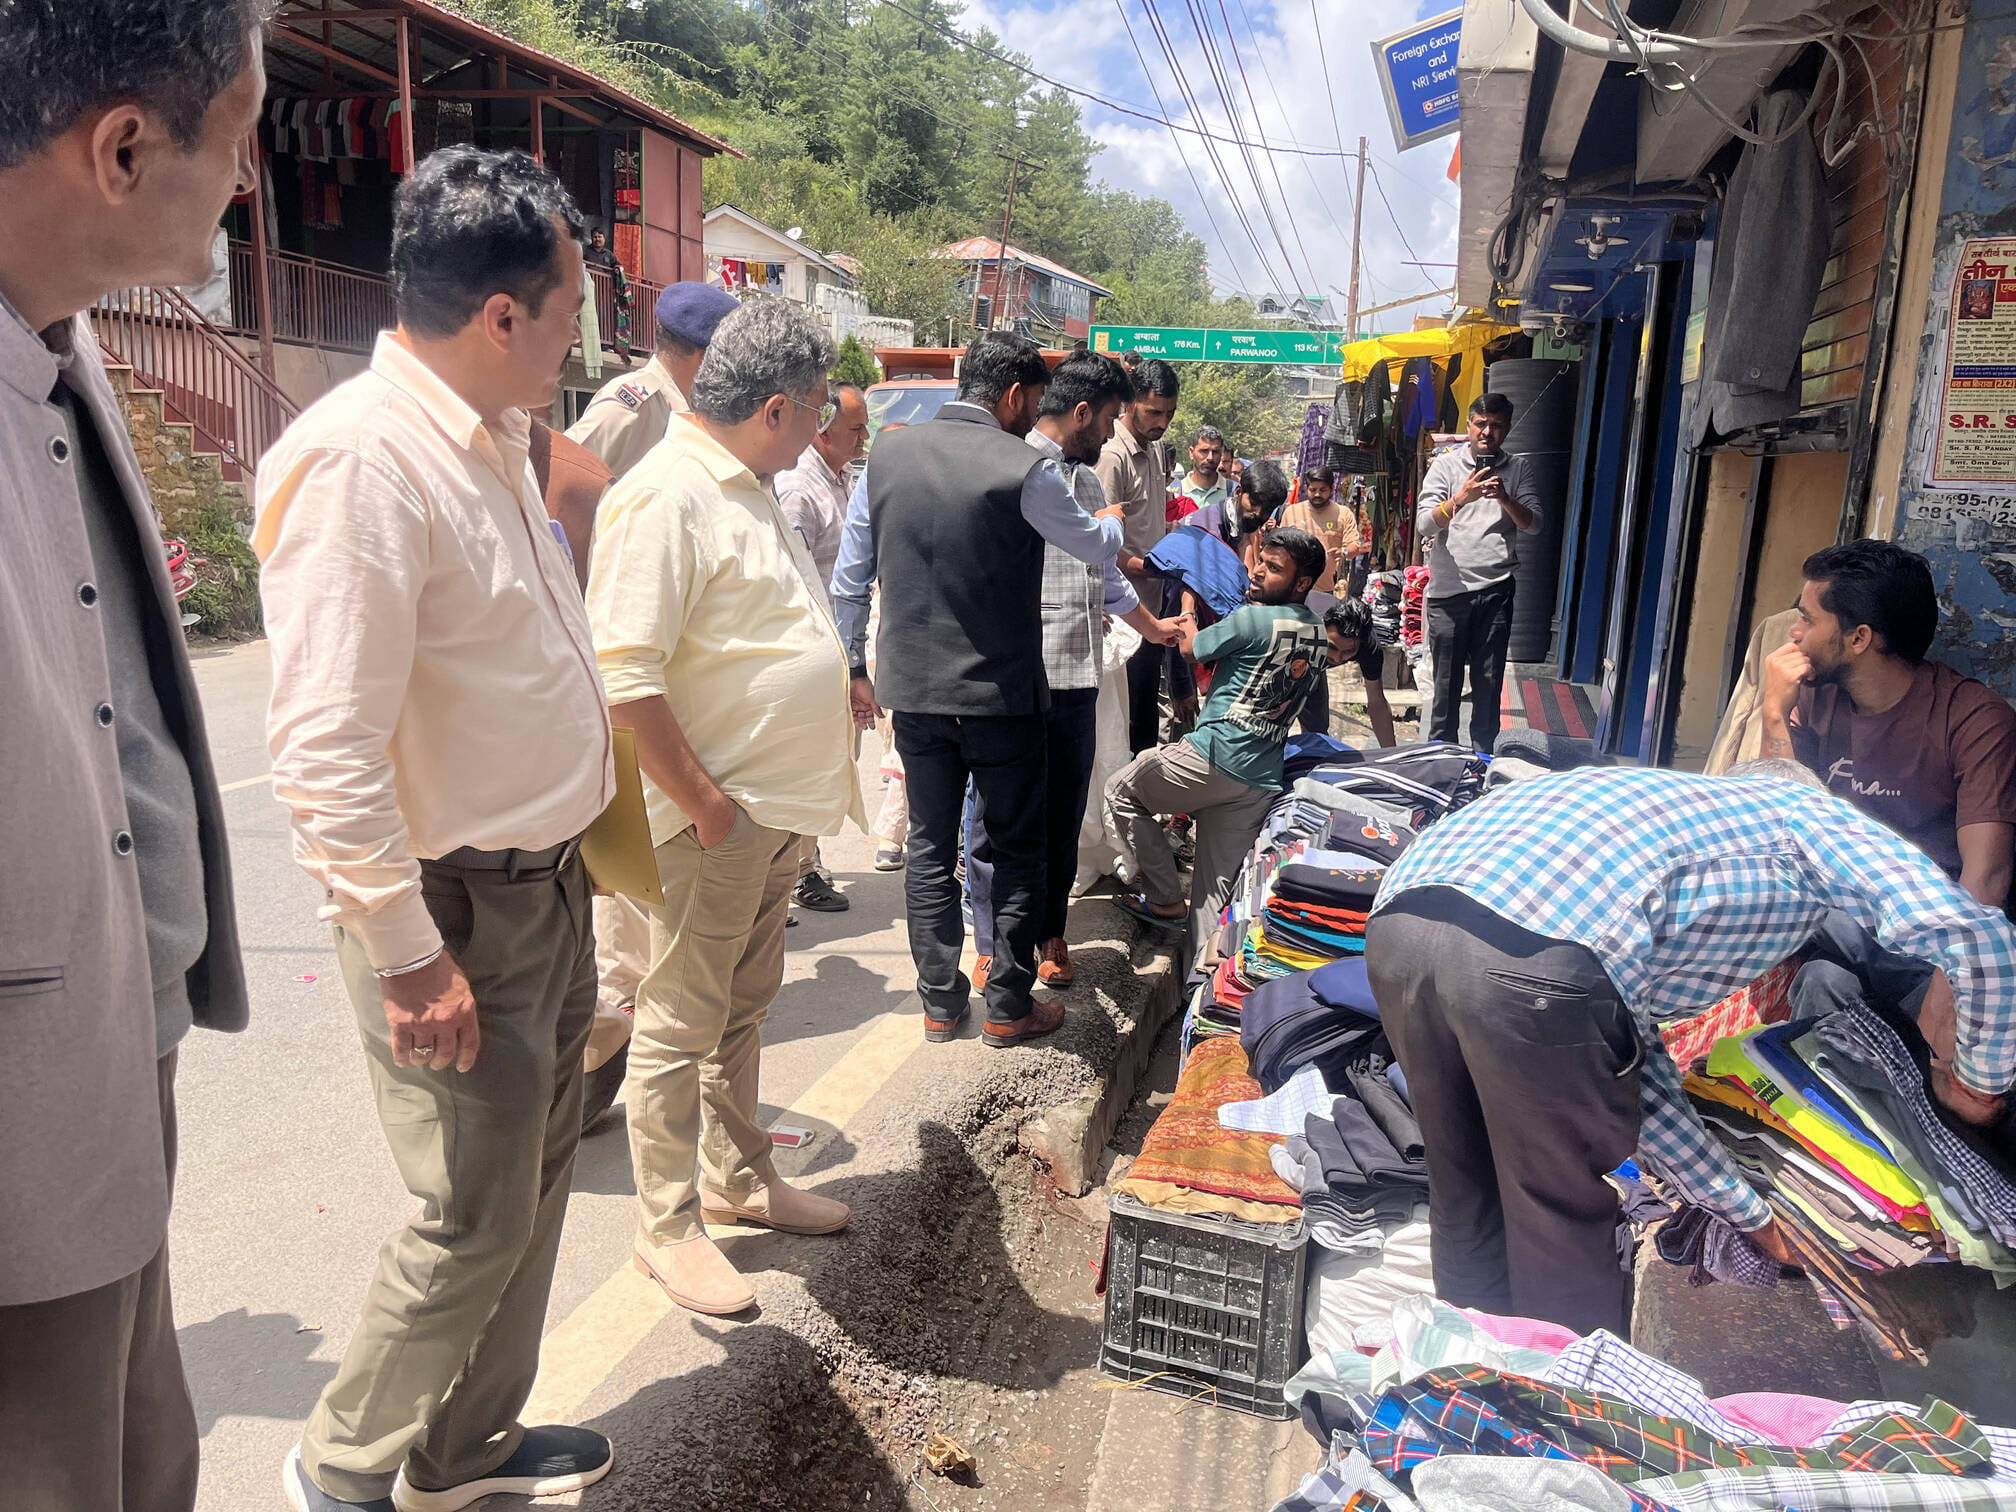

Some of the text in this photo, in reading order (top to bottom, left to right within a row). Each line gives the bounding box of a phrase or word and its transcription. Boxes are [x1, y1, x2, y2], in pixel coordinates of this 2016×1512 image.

[1392, 43, 1428, 64] Foreign
[1428, 50, 1447, 68] and
[1412, 74, 1430, 91] NRI
[1963, 259, 2008, 278] तीन
[1133, 345, 1167, 354] AMBALA
[1230, 348, 1278, 358] PARWANOO
[1949, 414, 1997, 429] S.R.
